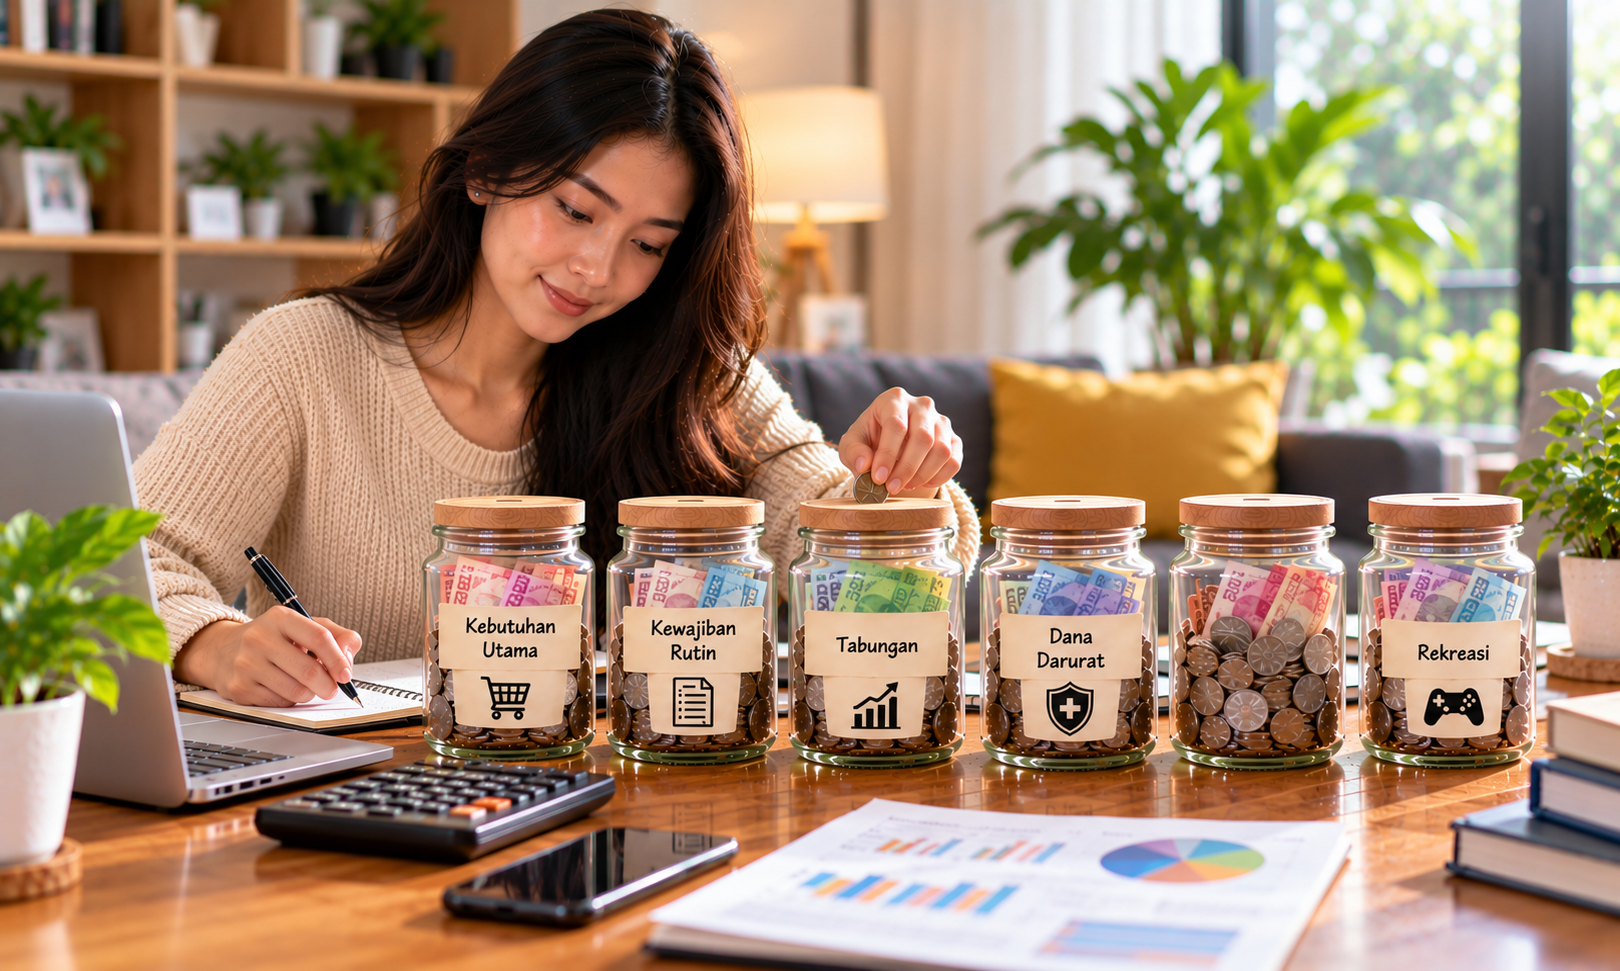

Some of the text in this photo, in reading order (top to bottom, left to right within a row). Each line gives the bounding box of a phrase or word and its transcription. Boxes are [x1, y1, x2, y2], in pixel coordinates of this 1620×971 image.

[466, 616, 556, 635] Kebutuhan
[651, 618, 736, 641] Kewajiban
[1050, 627, 1093, 645] Dana
[483, 640, 538, 658] Utama
[670, 643, 717, 661] Rutin
[835, 635, 918, 659] Tabungan
[1418, 643, 1490, 661] Rekreasi
[1037, 651, 1106, 669] Darurat
